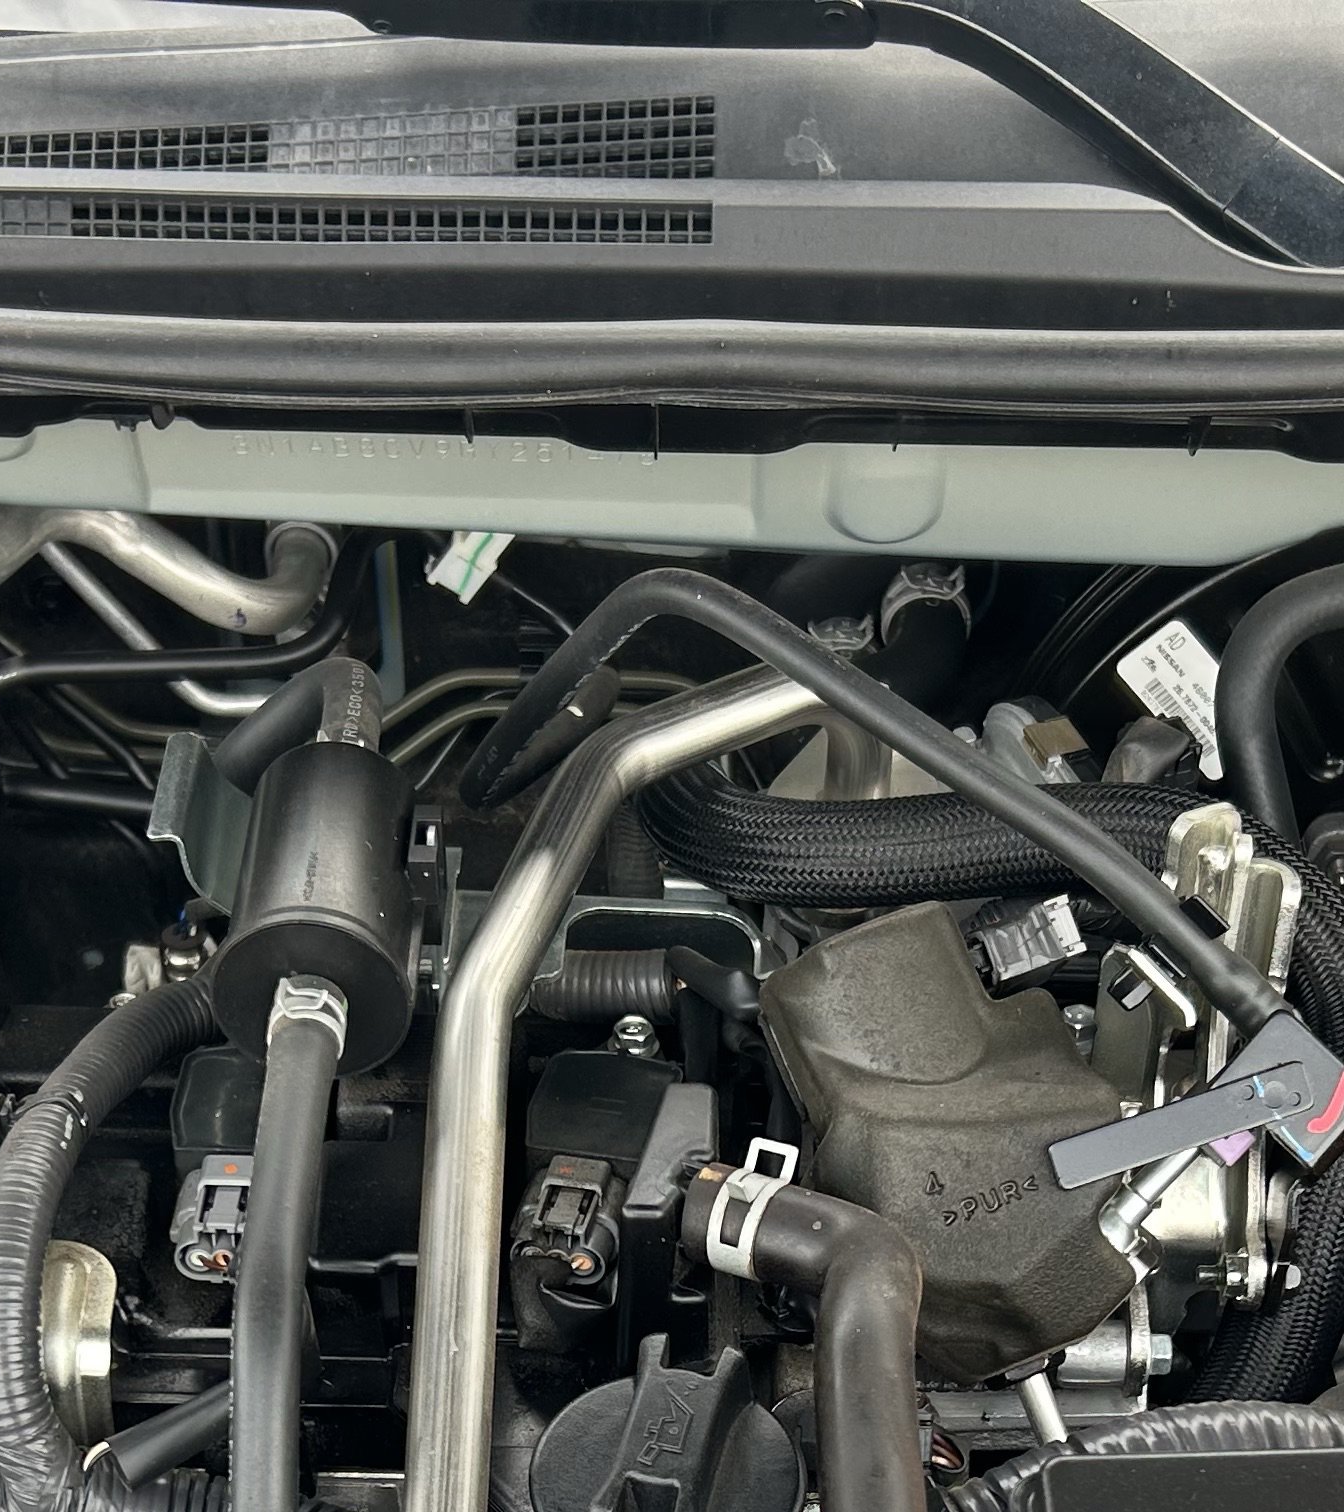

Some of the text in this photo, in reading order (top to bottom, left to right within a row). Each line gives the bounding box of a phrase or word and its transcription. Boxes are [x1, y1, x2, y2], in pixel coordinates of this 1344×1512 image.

[1156, 644, 1186, 678] NISSAN
[924, 1170, 944, 1196] 4
[942, 1175, 1039, 1227] >PUR<
